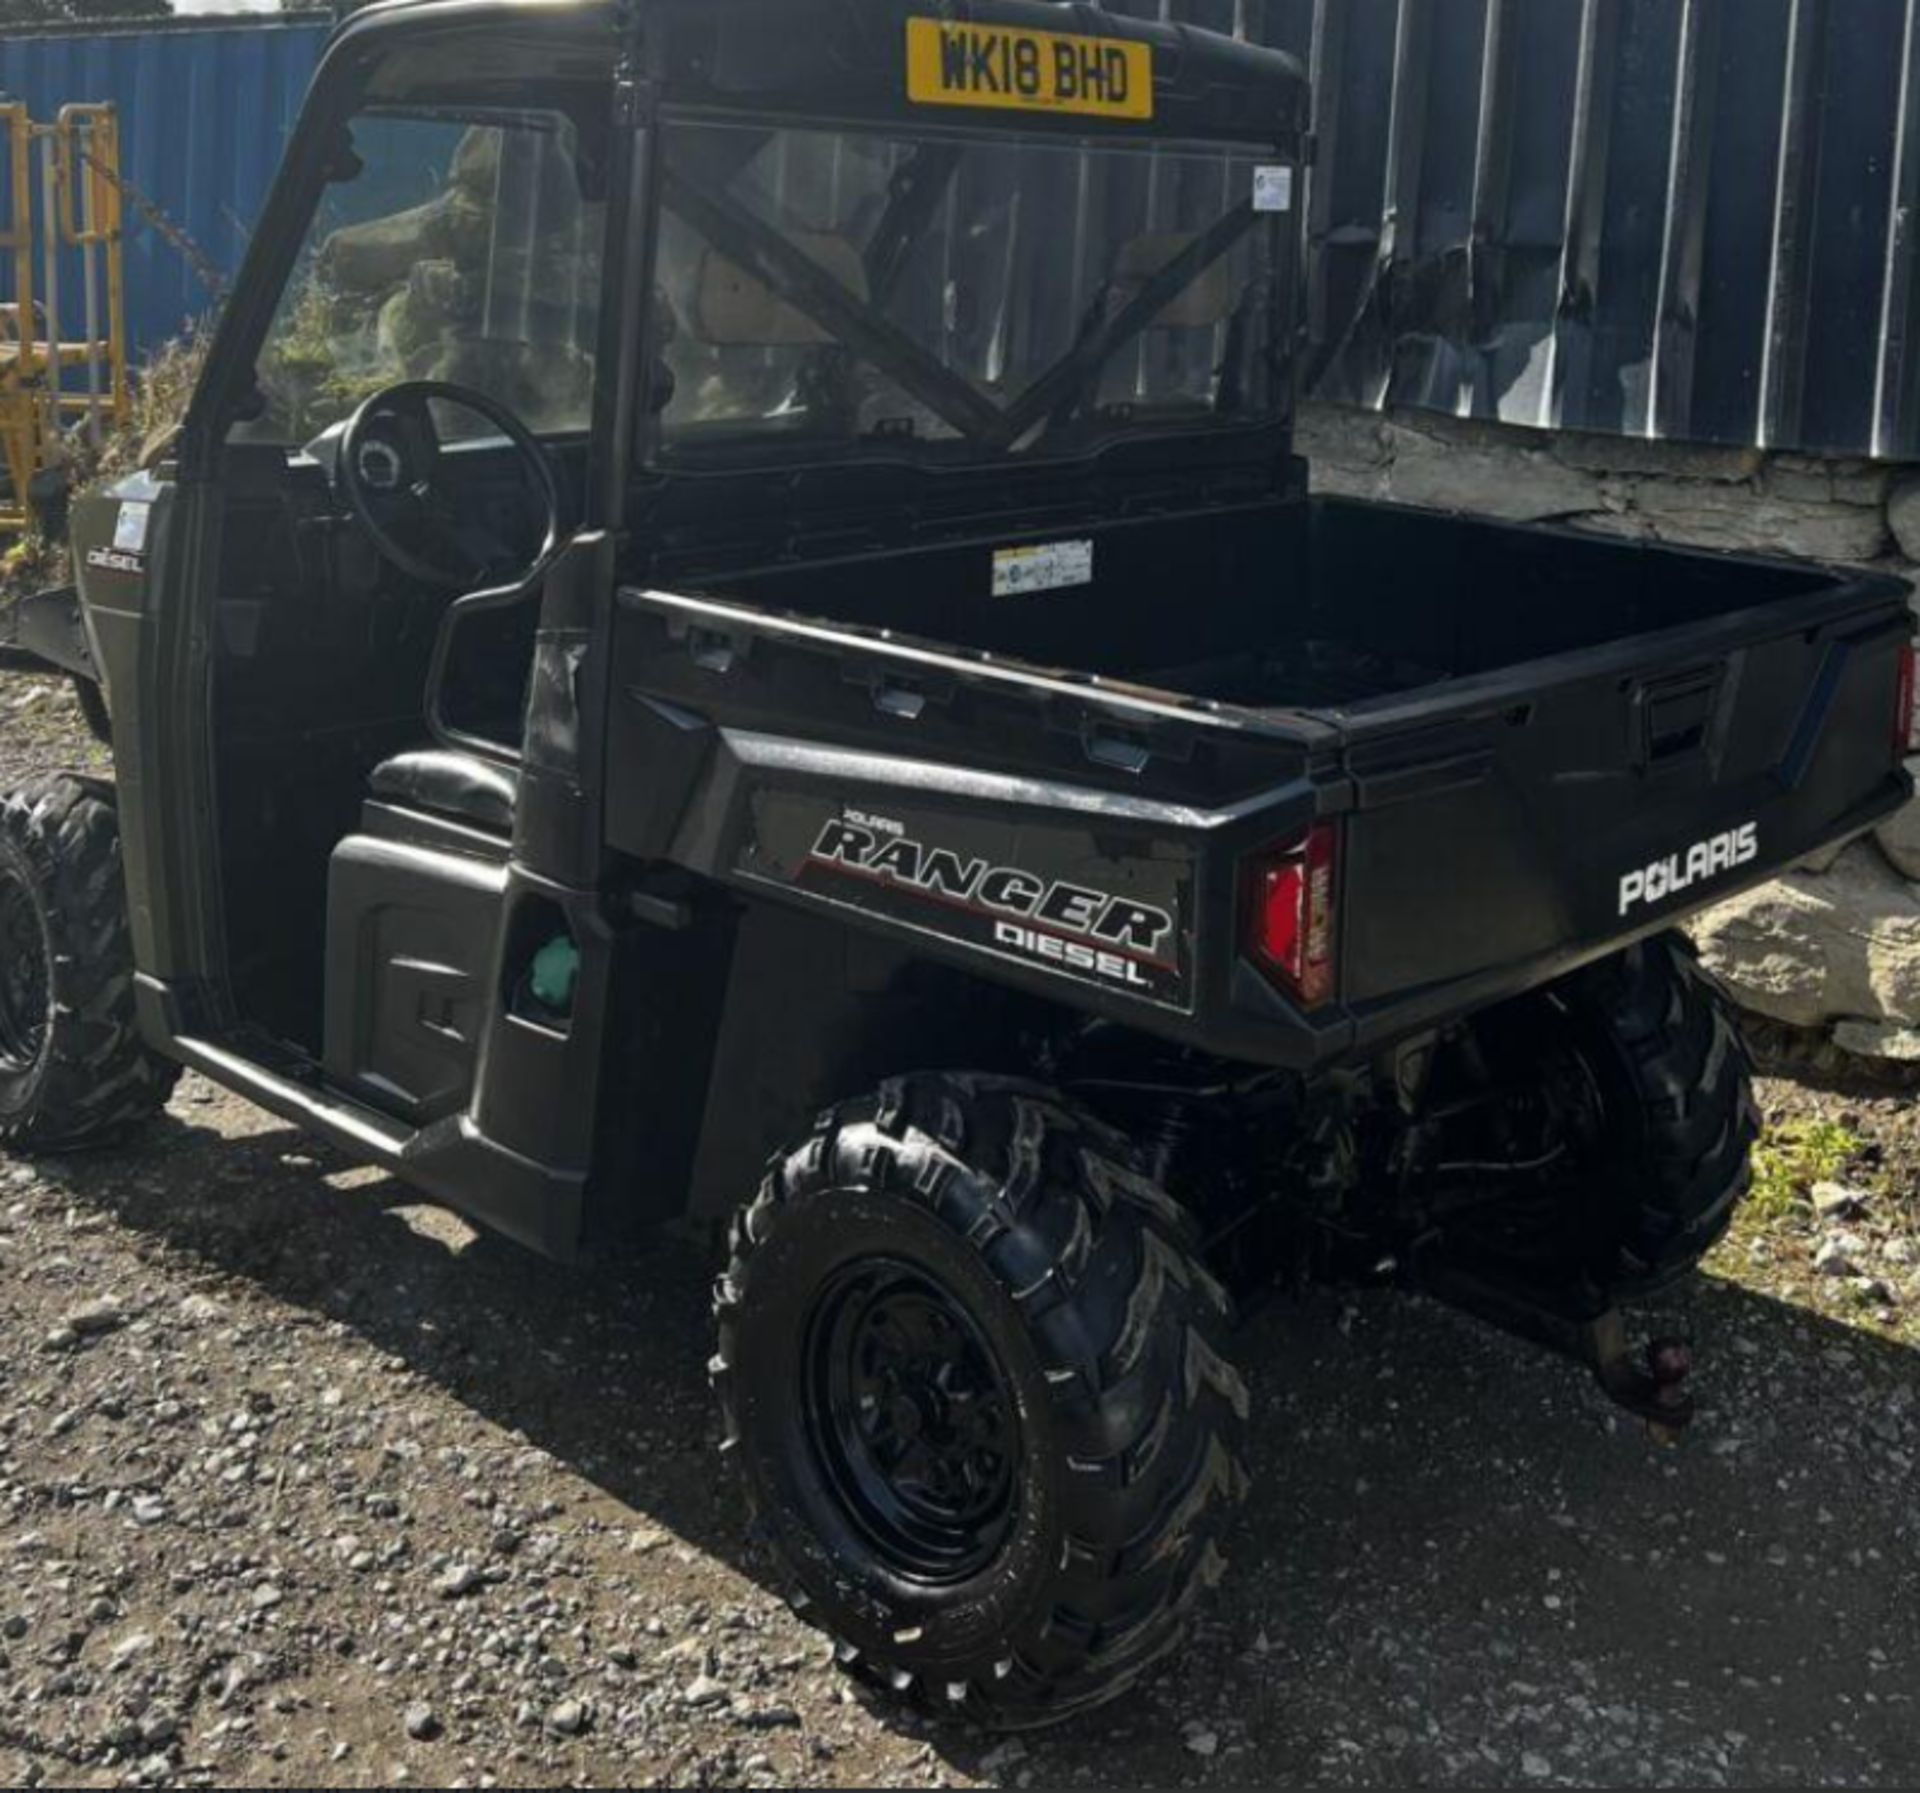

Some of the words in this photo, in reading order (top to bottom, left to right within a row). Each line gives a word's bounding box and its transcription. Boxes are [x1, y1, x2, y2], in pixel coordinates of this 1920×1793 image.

[940, 29, 1041, 95] WK18
[1052, 40, 1127, 103] BHD
[810, 818, 1173, 954] RANGER
[1617, 820, 1758, 917] POLARIS
[994, 920, 1149, 986] DIESEL
